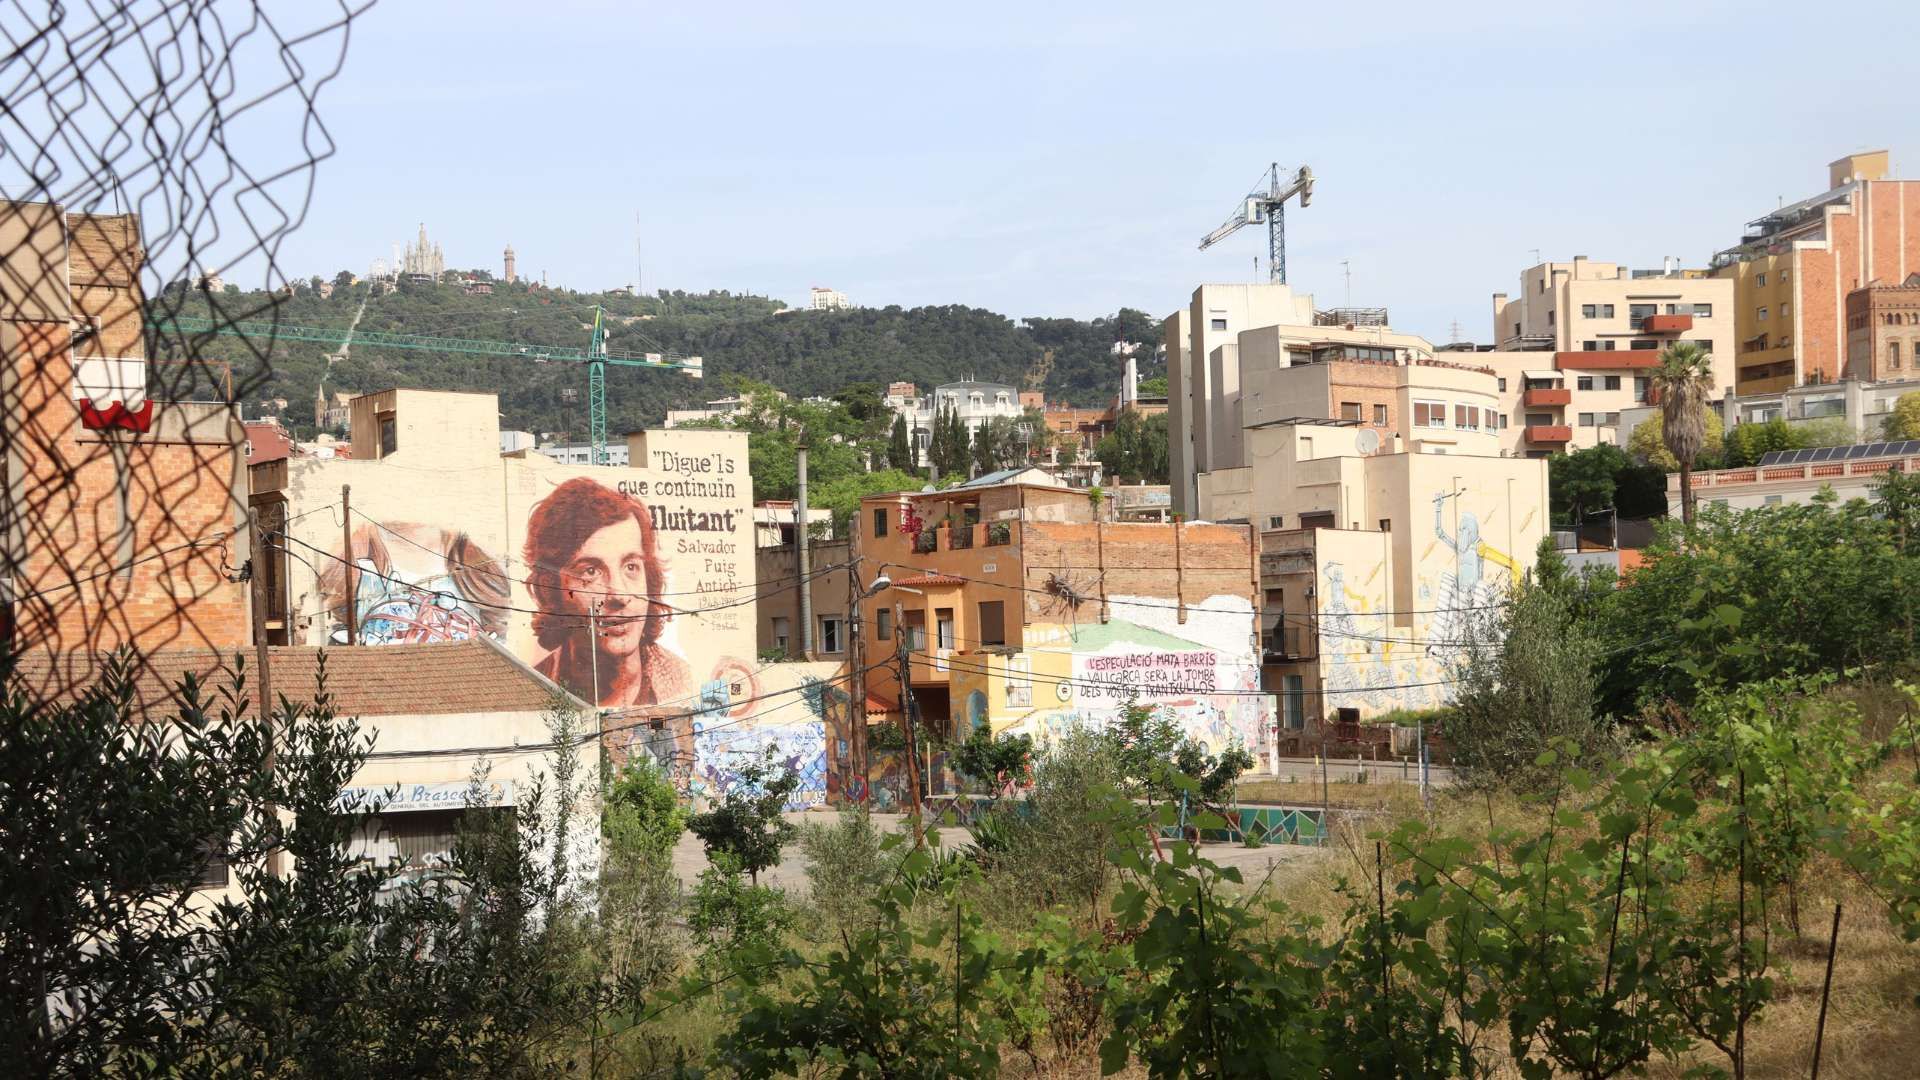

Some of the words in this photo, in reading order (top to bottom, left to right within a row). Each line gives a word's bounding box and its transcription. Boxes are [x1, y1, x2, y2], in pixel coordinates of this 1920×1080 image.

[617, 479, 648, 500] que
[655, 478, 736, 498] continuïn
[677, 538, 736, 554] Salvador
[704, 558, 737, 578] Puig
[696, 579, 738, 593] Antich
[1156, 653, 1179, 668] MATA
[1172, 669, 1182, 682] LA
[1184, 668, 1215, 682] TOMBA
[1080, 685, 1101, 698] DELS
